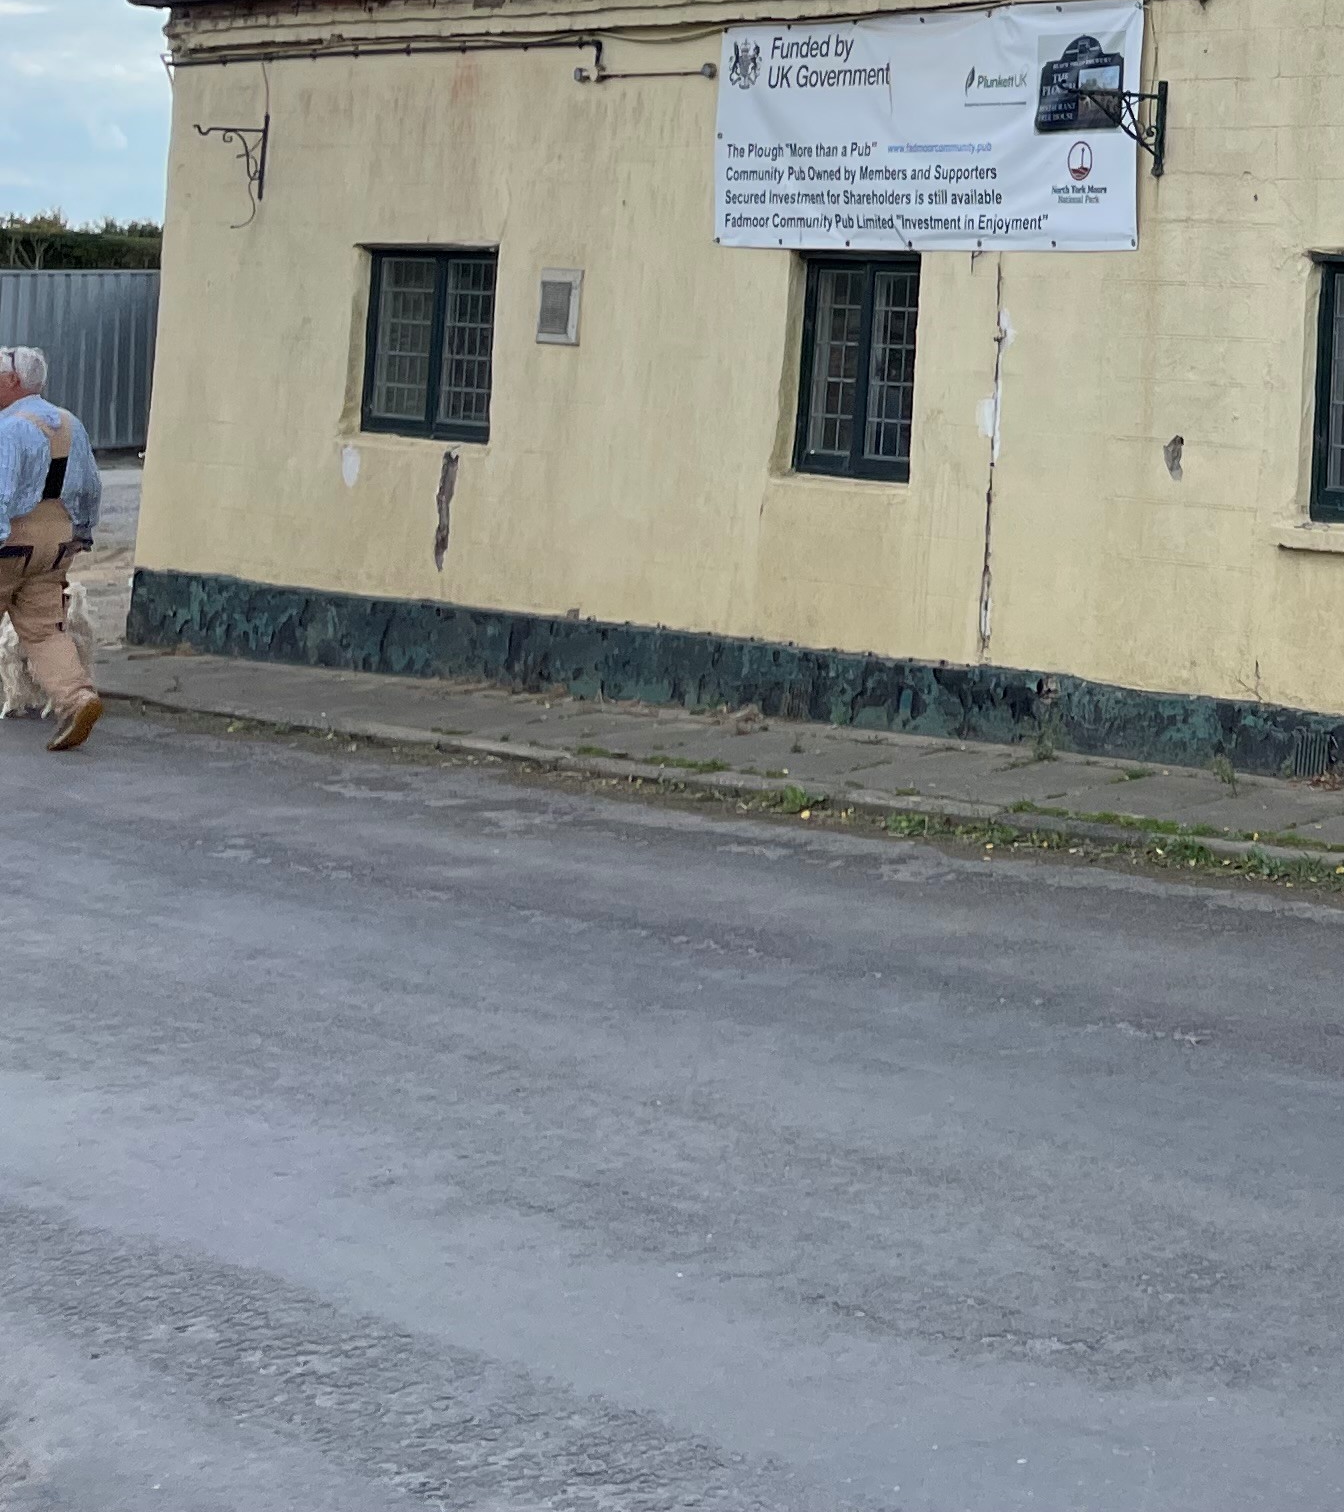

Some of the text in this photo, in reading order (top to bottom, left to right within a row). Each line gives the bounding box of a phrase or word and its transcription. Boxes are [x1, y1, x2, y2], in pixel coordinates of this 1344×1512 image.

[771, 34, 854, 62] Funded by
[768, 62, 890, 88] UK Government
[727, 143, 745, 158] The
[748, 143, 784, 161] Plough
[815, 142, 838, 158] than
[840, 145, 847, 157] a
[850, 141, 878, 157] Pub"
[726, 164, 997, 185] Community Pub Owned by Members and Supporters
[725, 189, 1002, 205] Secured Investment for Shareholders is still available
[725, 213, 1049, 234] Fadmoor Community Pub Limited "Investment in Enjoyment"
